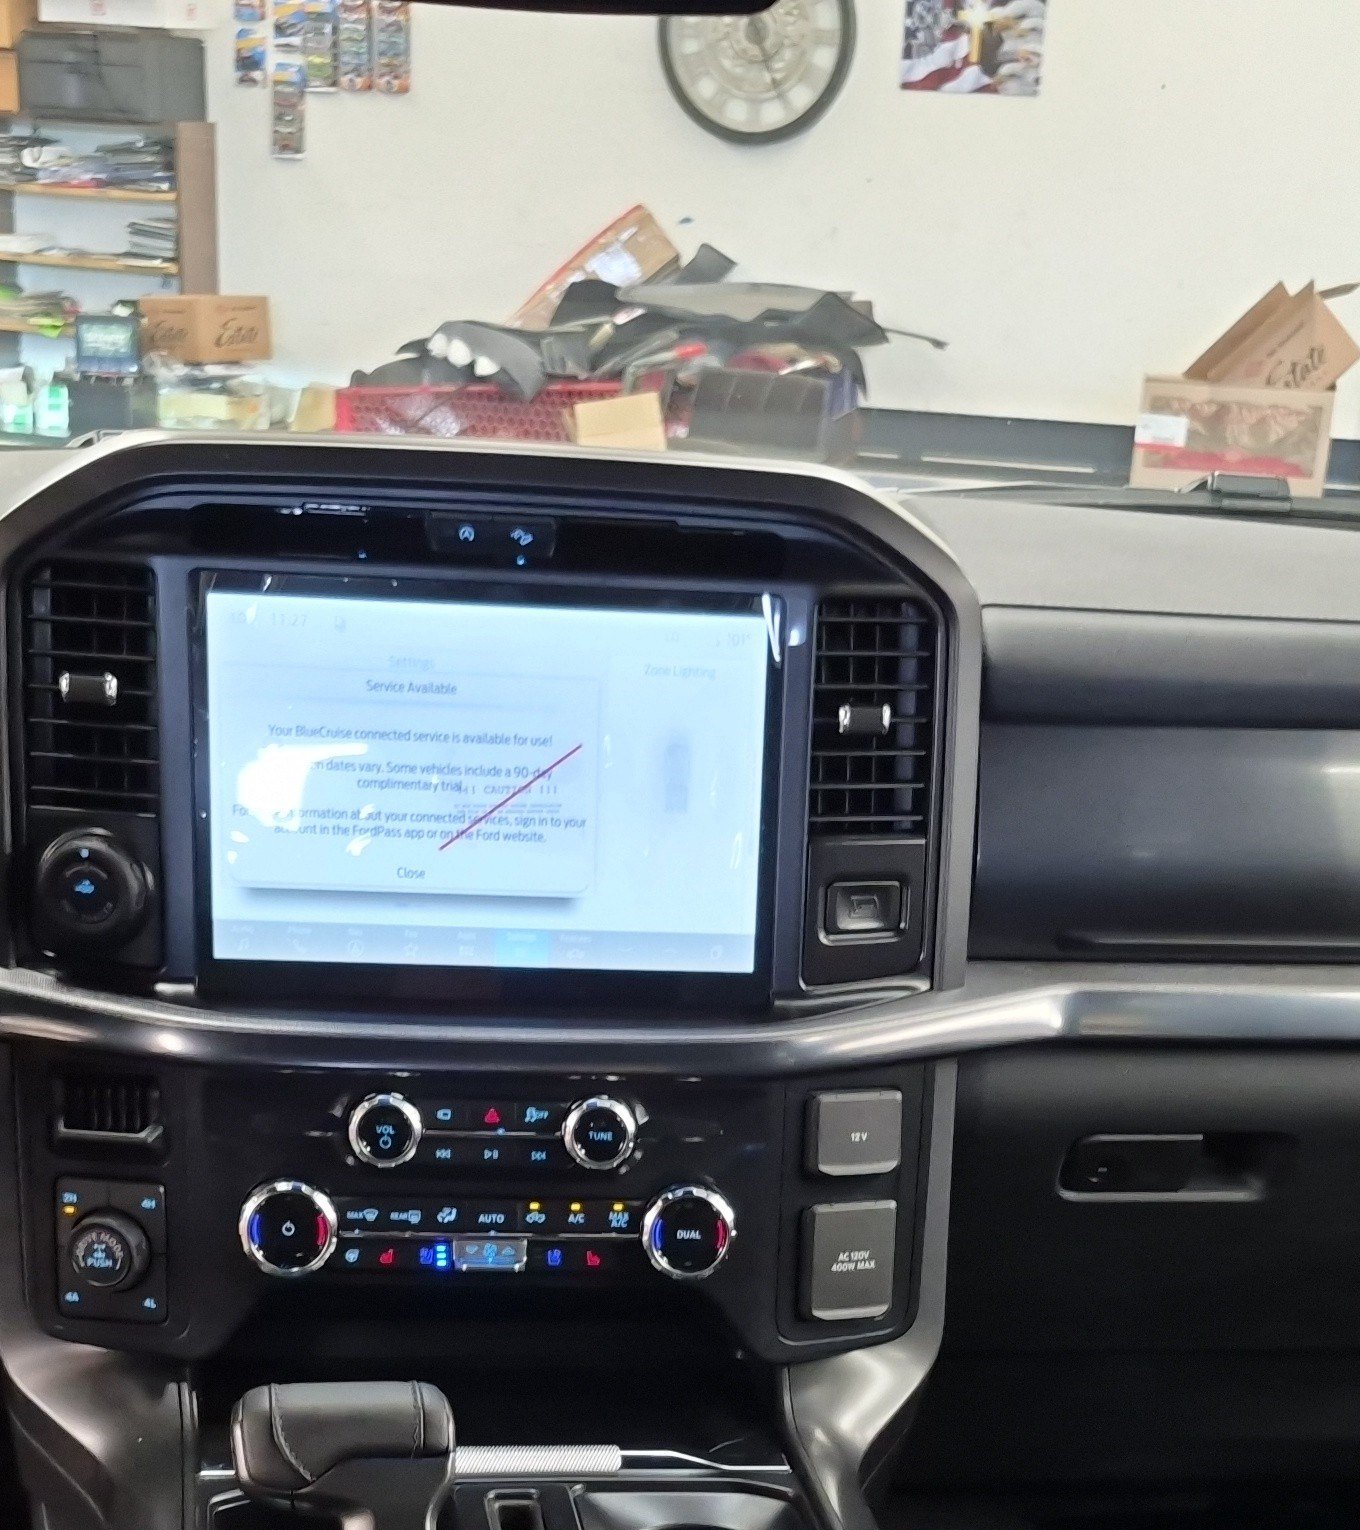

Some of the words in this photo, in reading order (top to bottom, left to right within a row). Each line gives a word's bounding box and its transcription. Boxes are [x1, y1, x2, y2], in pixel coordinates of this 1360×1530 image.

[366, 679, 405, 693] Service
[407, 681, 458, 695] Available
[268, 724, 293, 737] Your
[295, 725, 352, 739] BlueCruise
[354, 728, 411, 741] connected
[413, 731, 449, 743] service
[452, 732, 461, 743] is
[463, 733, 511, 745] available
[513, 733, 528, 745] for
[530, 735, 553, 747] use!
[326, 759, 357, 772] dates
[386, 761, 418, 774] Some
[420, 763, 463, 776] vehicles
[464, 764, 503, 777] include
[505, 769, 512, 778] a
[357, 777, 439, 793] complimentary
[384, 812, 408, 824] your
[410, 813, 466, 825] connected
[515, 816, 536, 830] sign
[538, 816, 548, 827] in
[550, 817, 561, 827] to
[563, 818, 586, 830] your
[320, 824, 330, 835] in
[332, 824, 350, 836] the
[352, 824, 402, 838] FordPass
[404, 828, 425, 840] app
[427, 830, 437, 840] or
[475, 829, 500, 841] Ford
[397, 867, 426, 879] Close
[375, 1125, 394, 1135] VOL
[588, 1130, 613, 1142] TUNE
[478, 1213, 505, 1225] AUTO
[567, 1213, 585, 1224] A/C
[610, 1219, 628, 1229] A/C
[676, 1230, 701, 1241] DUAL
[838, 1251, 849, 1262] AC
[850, 1250, 870, 1261] 120V
[86, 1258, 113, 1269] PUSH
[831, 1261, 855, 1272] 400W
[857, 1259, 876, 1270] MAX
